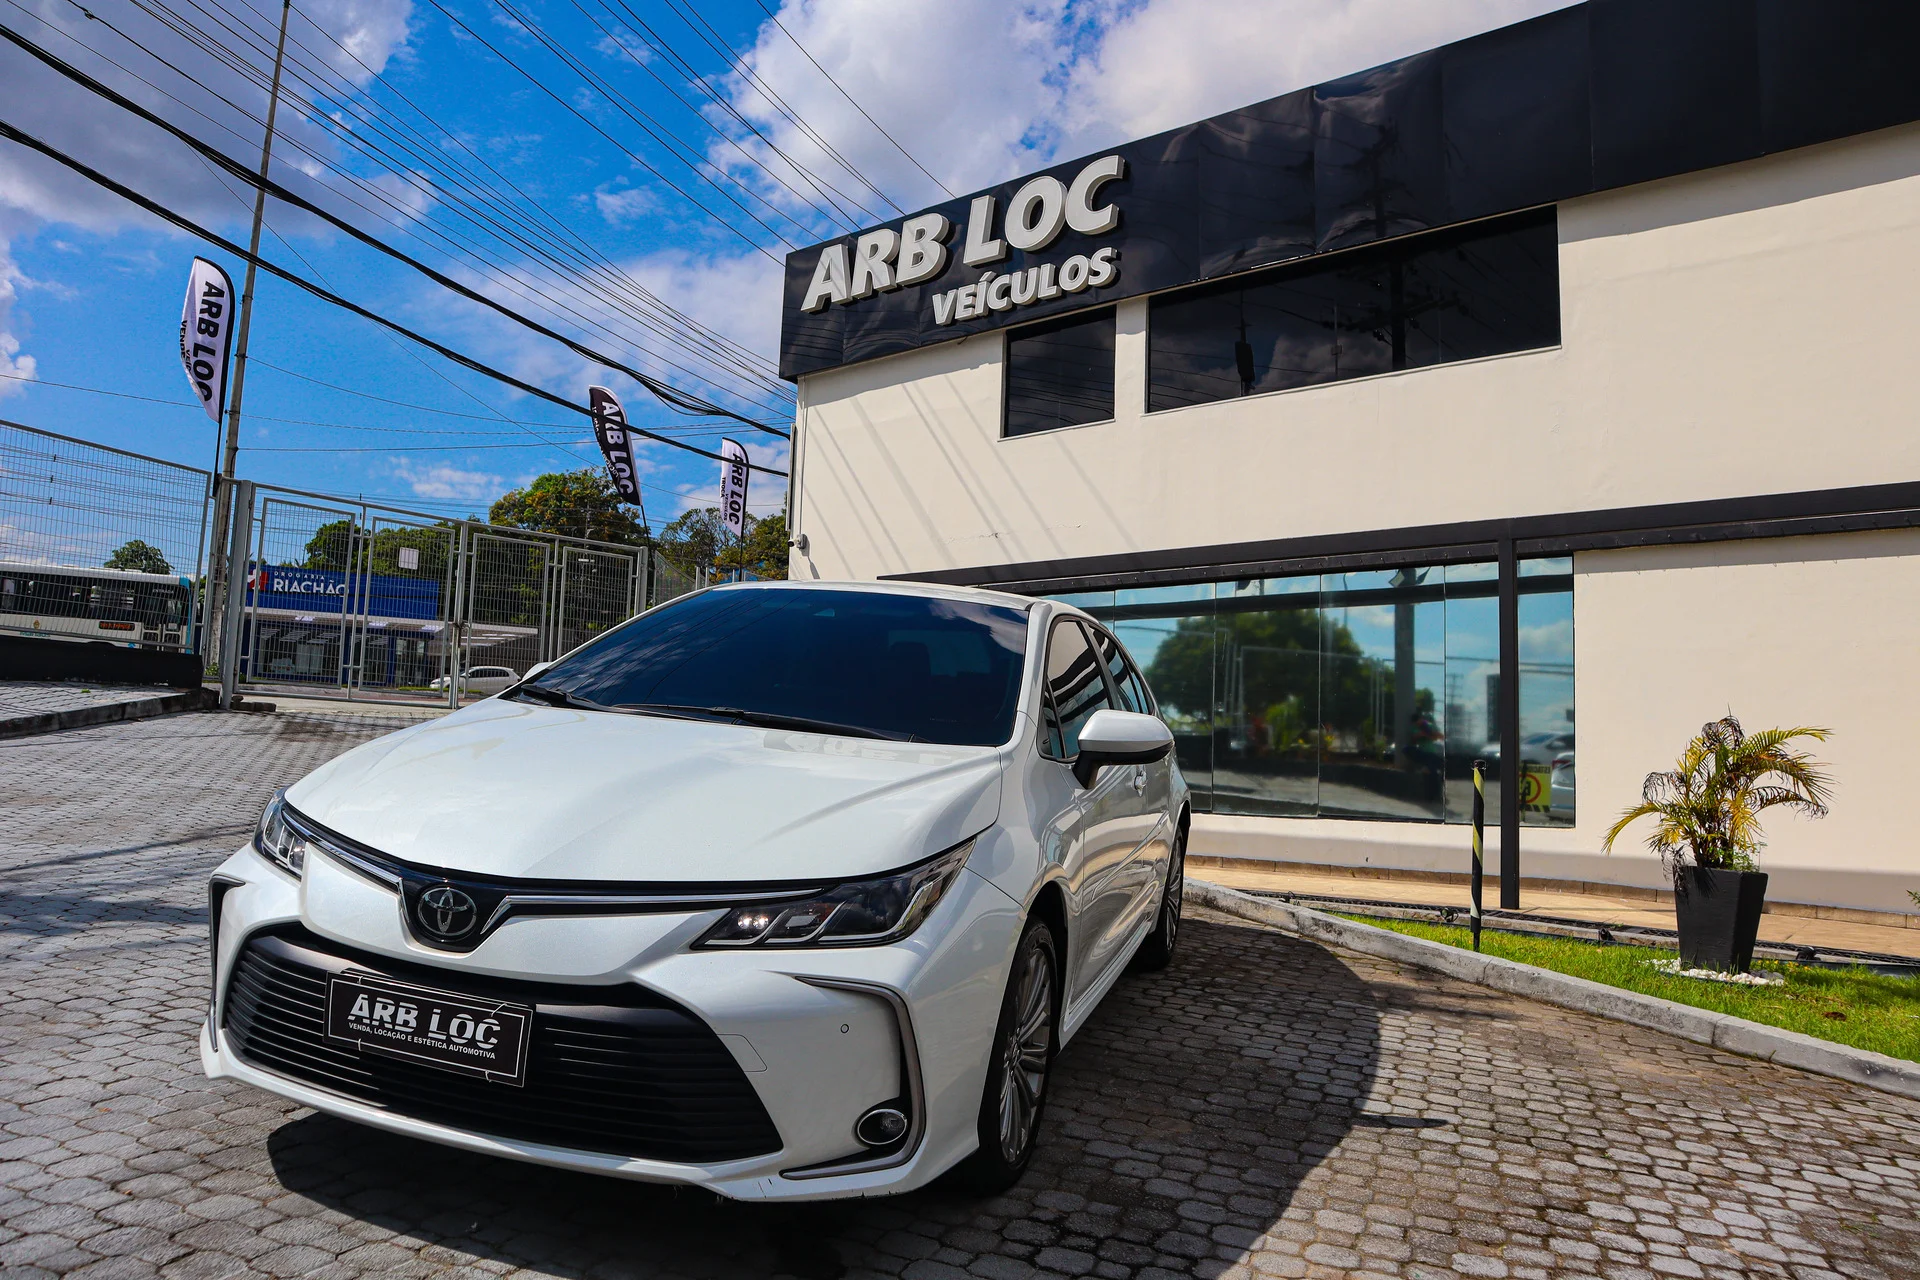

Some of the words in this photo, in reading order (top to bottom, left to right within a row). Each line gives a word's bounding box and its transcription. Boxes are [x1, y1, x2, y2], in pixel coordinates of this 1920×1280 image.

[801, 212, 950, 313] ARB
[963, 154, 1126, 267] LOC
[932, 246, 1118, 327] VEÍCULOS
[197, 281, 225, 338] ARB
[609, 450, 634, 495] LOC
[728, 490, 743, 526] LOC
[273, 578, 350, 595] RIACHÃO
[274, 570, 325, 580] DROGARIA
[347, 993, 420, 1034] ARB
[427, 1008, 502, 1050] LOC
[348, 1022, 373, 1034] VENDA,
[374, 1027, 406, 1041] LOCAÇÃO
[414, 1035, 448, 1050] ESTÉTICA
[448, 1044, 497, 1060] AUTOMOTIVA
